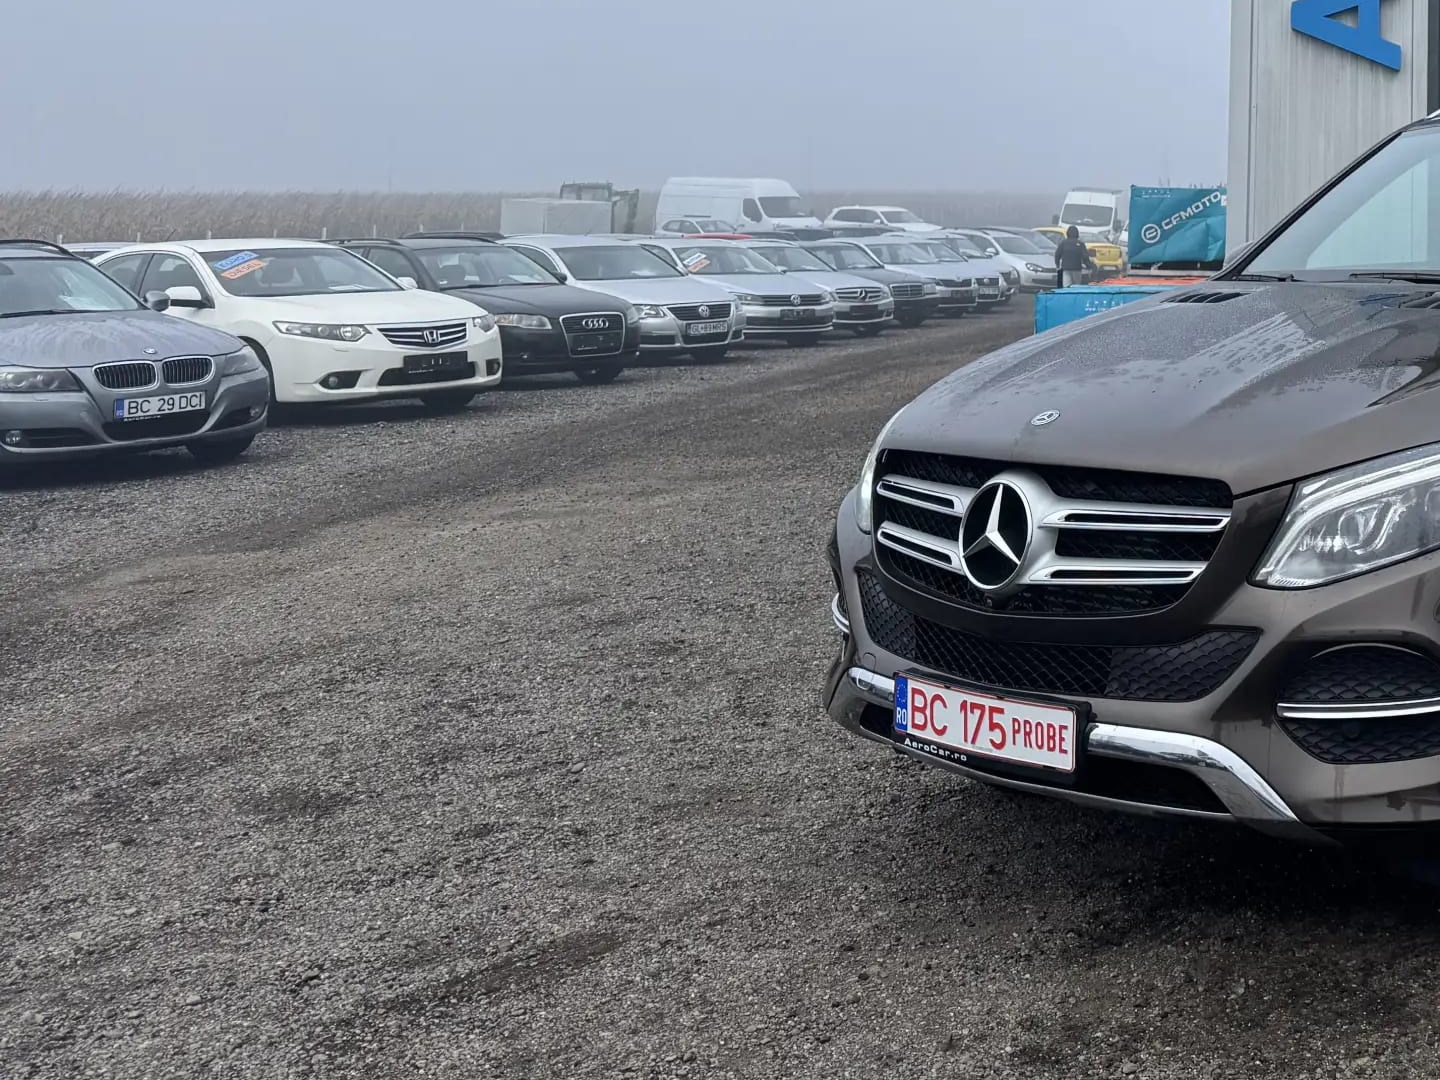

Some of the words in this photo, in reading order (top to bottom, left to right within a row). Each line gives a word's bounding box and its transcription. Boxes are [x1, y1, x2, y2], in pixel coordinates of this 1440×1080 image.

[1161, 191, 1221, 230] CFMOTO
[128, 400, 151, 415] BC
[157, 397, 175, 412] 29
[179, 394, 202, 409] DCI
[896, 707, 907, 725] RO
[911, 687, 948, 736] BC
[959, 699, 1007, 750] 175
[1011, 717, 1068, 754] PROBE
[904, 738, 967, 761] AeroCar.ro
